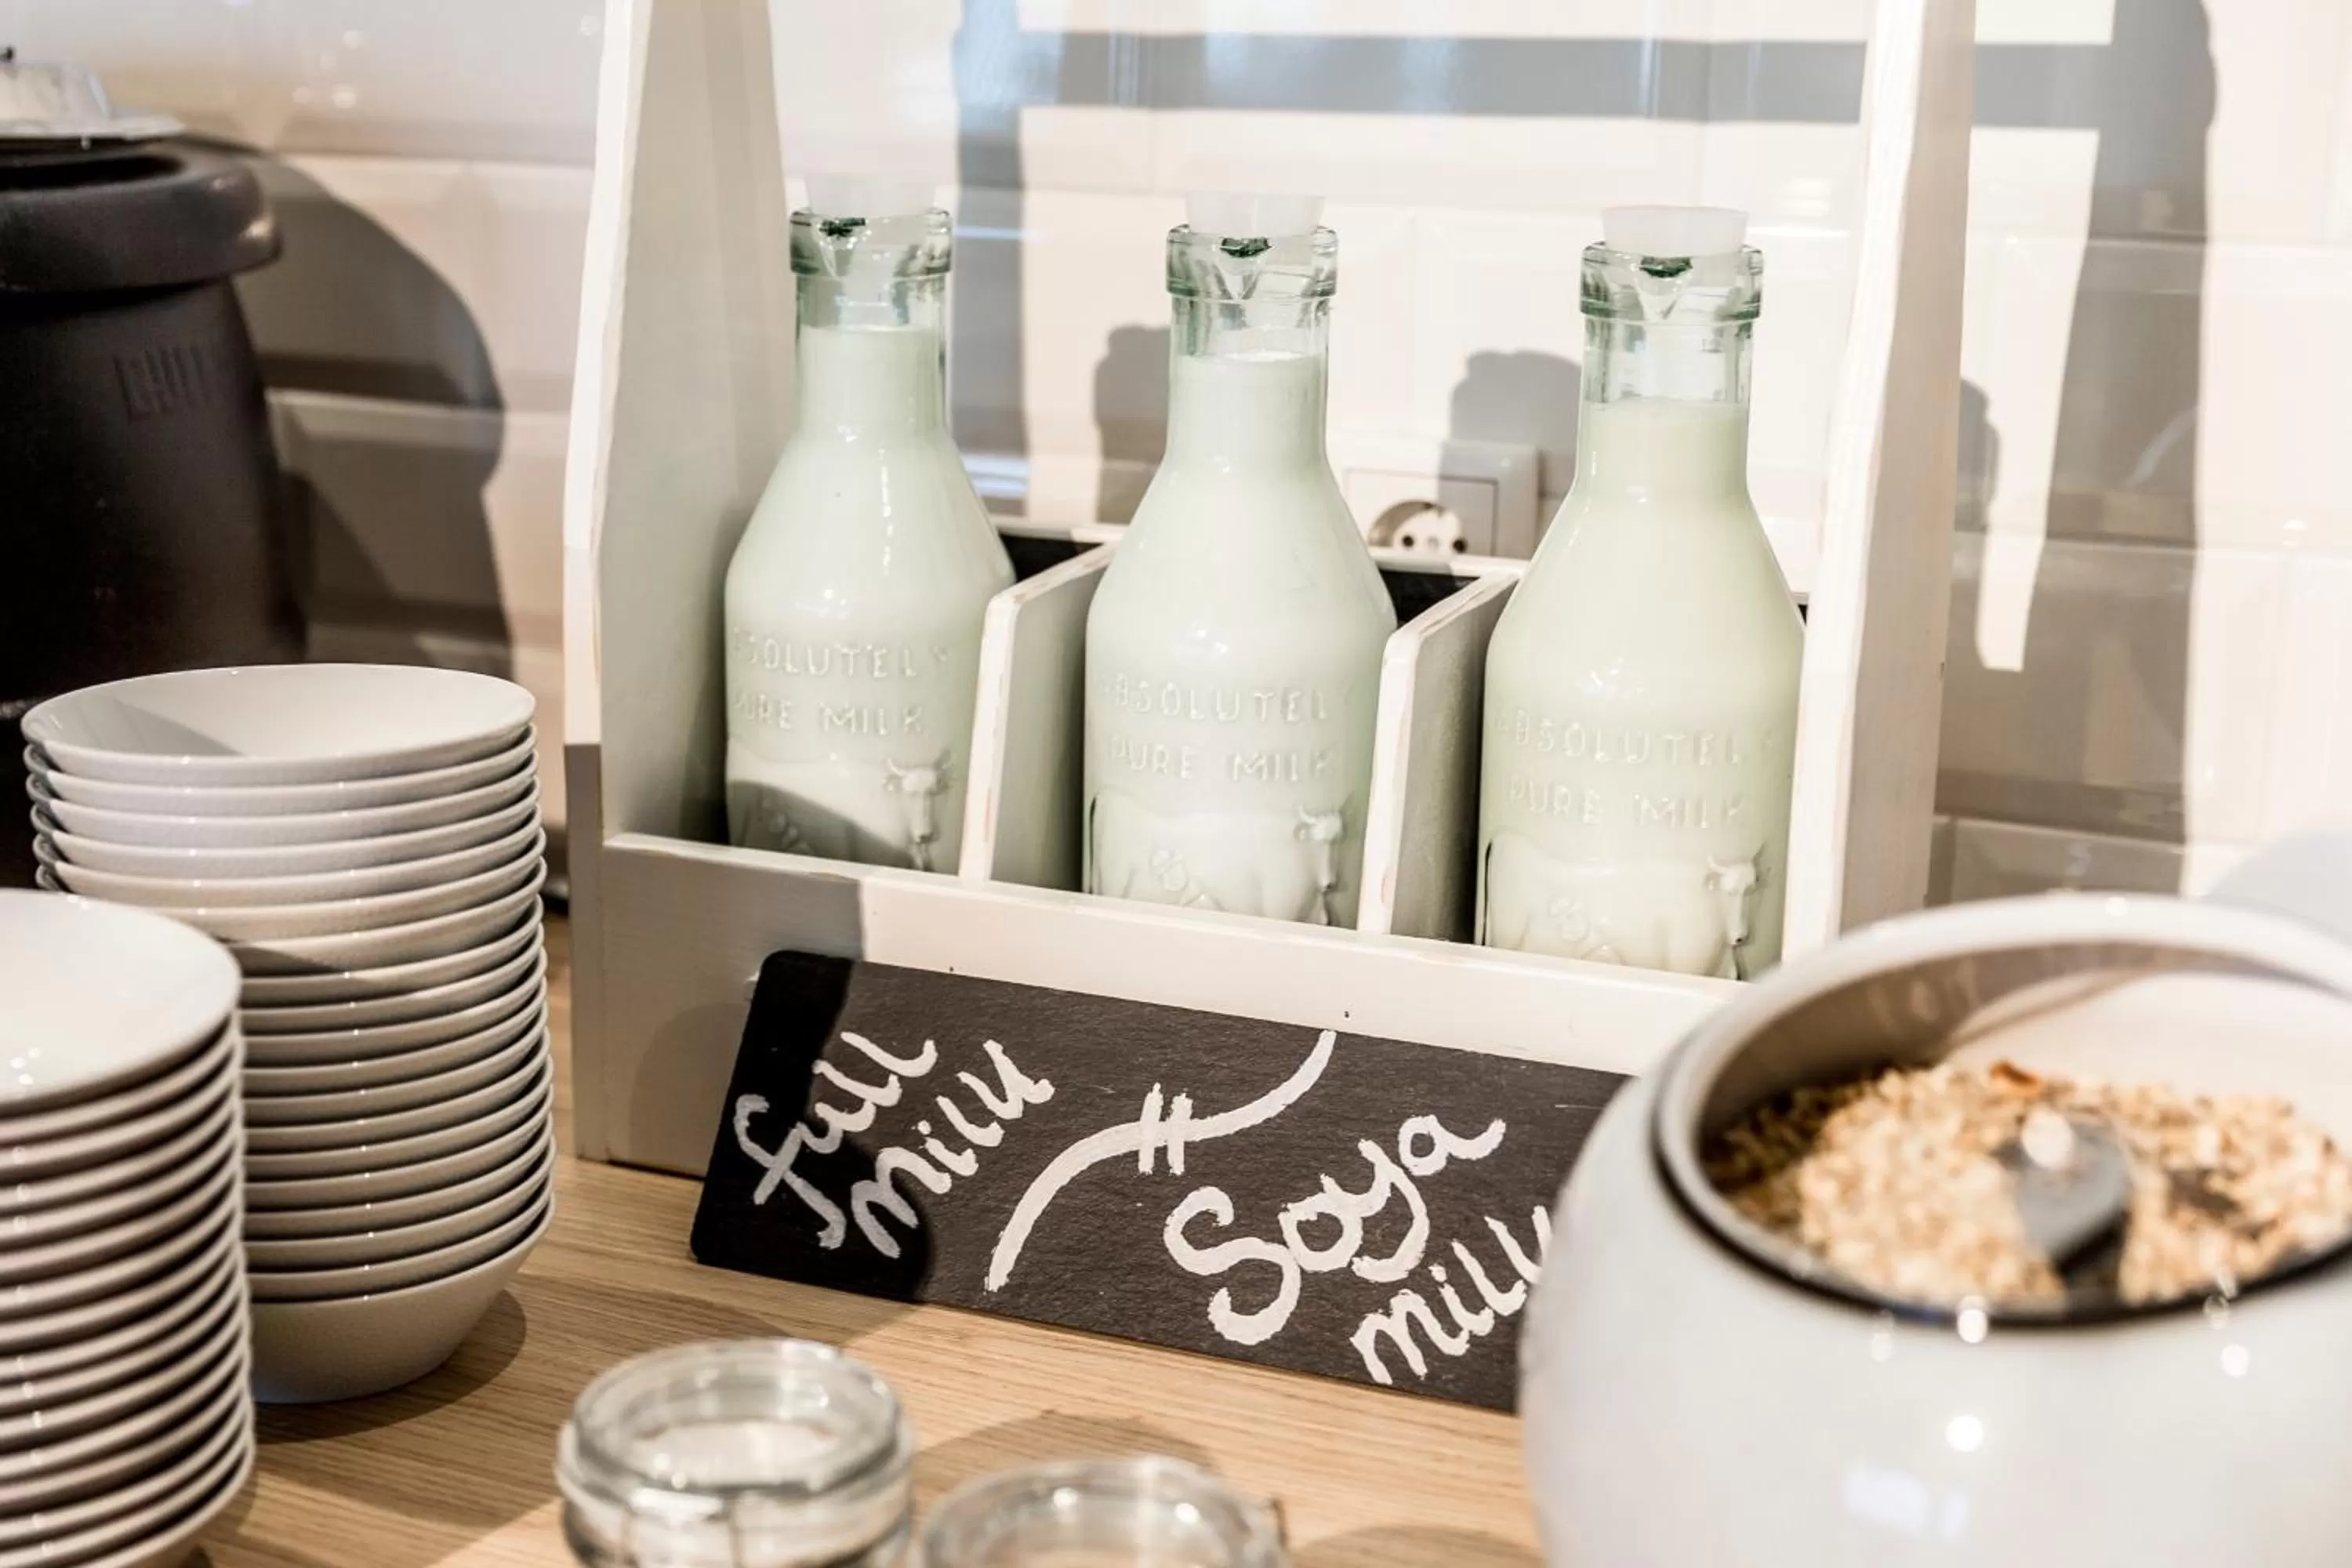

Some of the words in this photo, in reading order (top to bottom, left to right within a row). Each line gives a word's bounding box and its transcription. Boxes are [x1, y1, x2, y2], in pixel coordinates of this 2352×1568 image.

[820, 702, 923, 736] MILK
[734, 1031, 938, 1250] full
[1163, 1115, 1507, 1346] Soya
